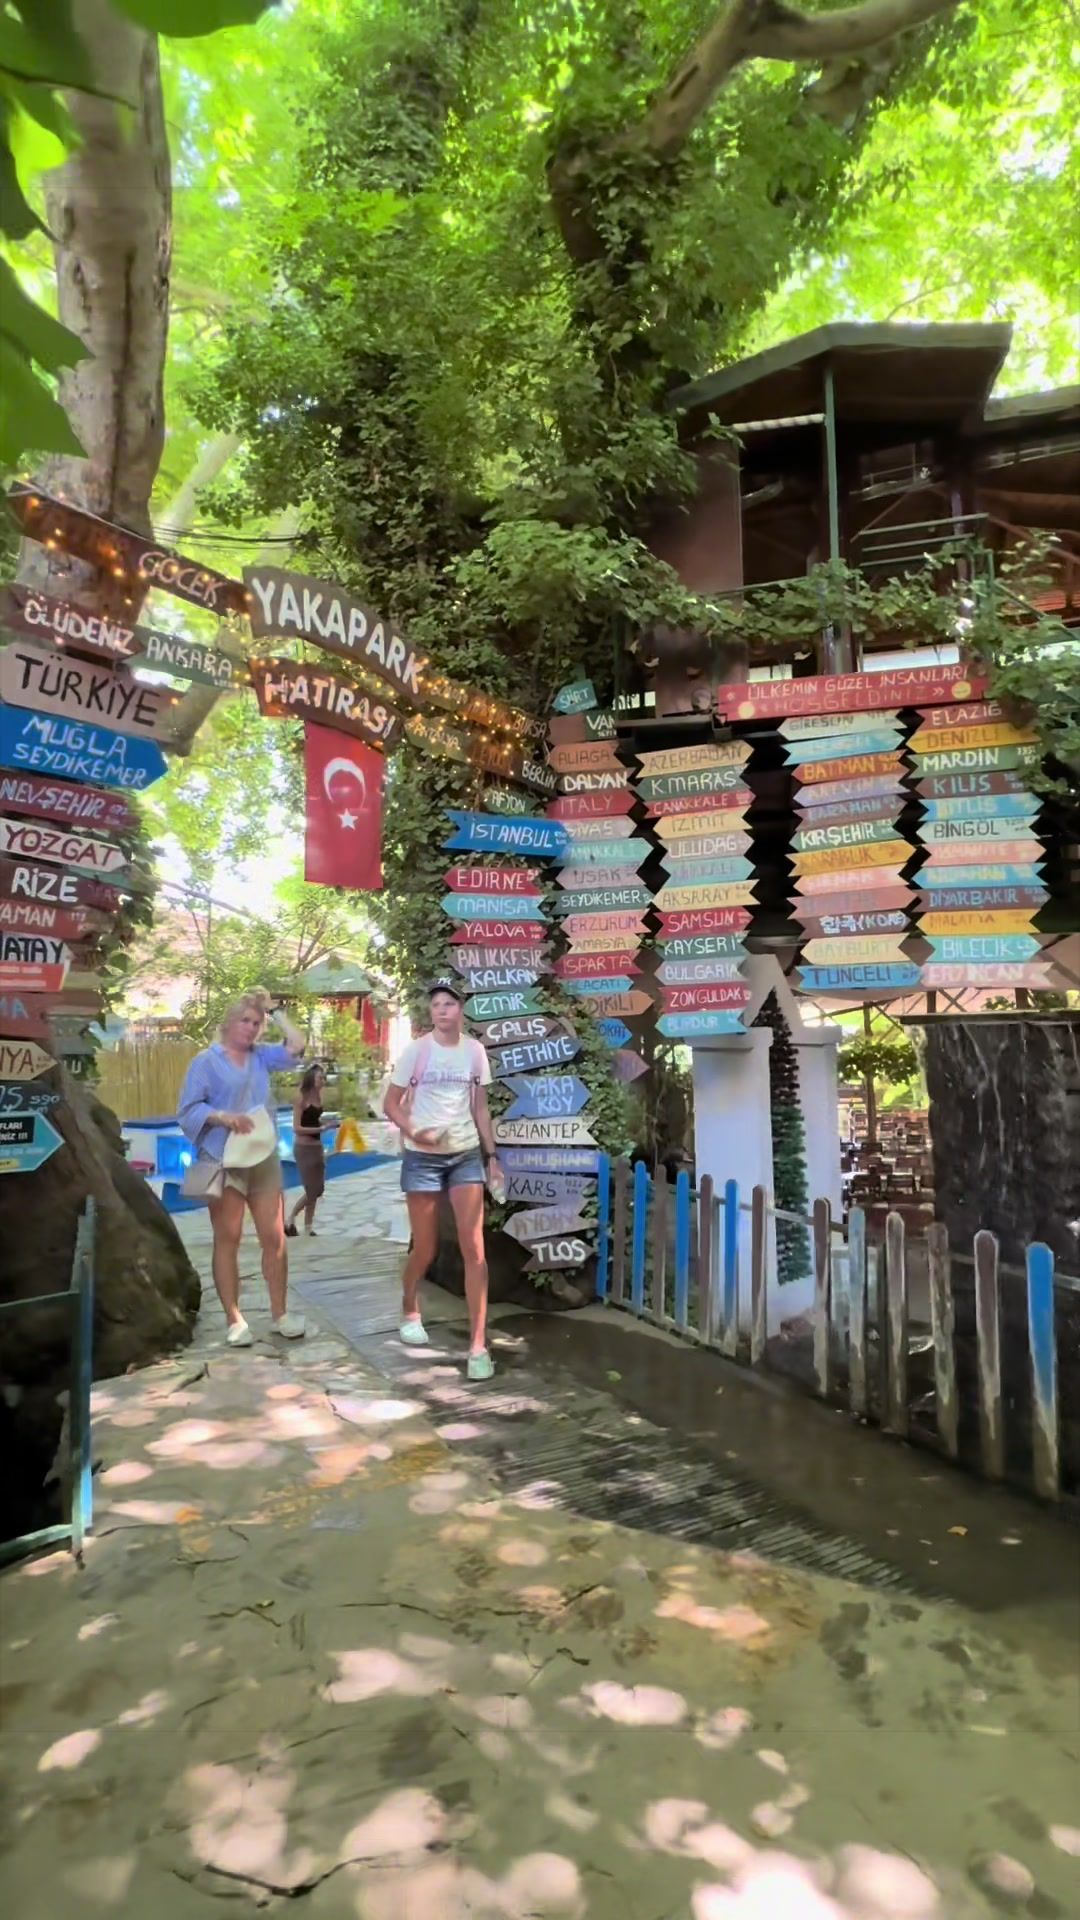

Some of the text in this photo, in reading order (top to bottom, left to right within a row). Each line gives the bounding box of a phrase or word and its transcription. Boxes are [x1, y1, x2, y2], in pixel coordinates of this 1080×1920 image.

[251, 577, 424, 694] YAKAPARK
[147, 636, 233, 679] ANKARA
[16, 653, 160, 727] TÜRKİYE
[264, 672, 396, 739] HATIRASI
[22, 714, 127, 765] MUĞLA
[13, 743, 147, 787] SEYDİKEMER
[564, 772, 628, 792] DALYAN
[561, 796, 615, 814] ITALY
[469, 817, 553, 848] İSTANBUL
[5, 824, 121, 867] YOZGAT
[11, 866, 79, 903] RİZE
[457, 867, 526, 890] EDİRNE
[463, 921, 527, 938] YALOVA
[570, 915, 638, 933] ERZURUM
[667, 910, 736, 933] SAMSUN
[564, 954, 633, 975] ISPARTA
[470, 967, 538, 988] KALKAN
[670, 986, 742, 1008] ZONGULDAK
[486, 1018, 547, 1042] ÇALIŞ
[501, 1036, 575, 1069] FETHİYE
[523, 1074, 575, 1098] YAKA
[508, 1176, 557, 1198] KARS
[531, 1239, 586, 1263] TLOS
